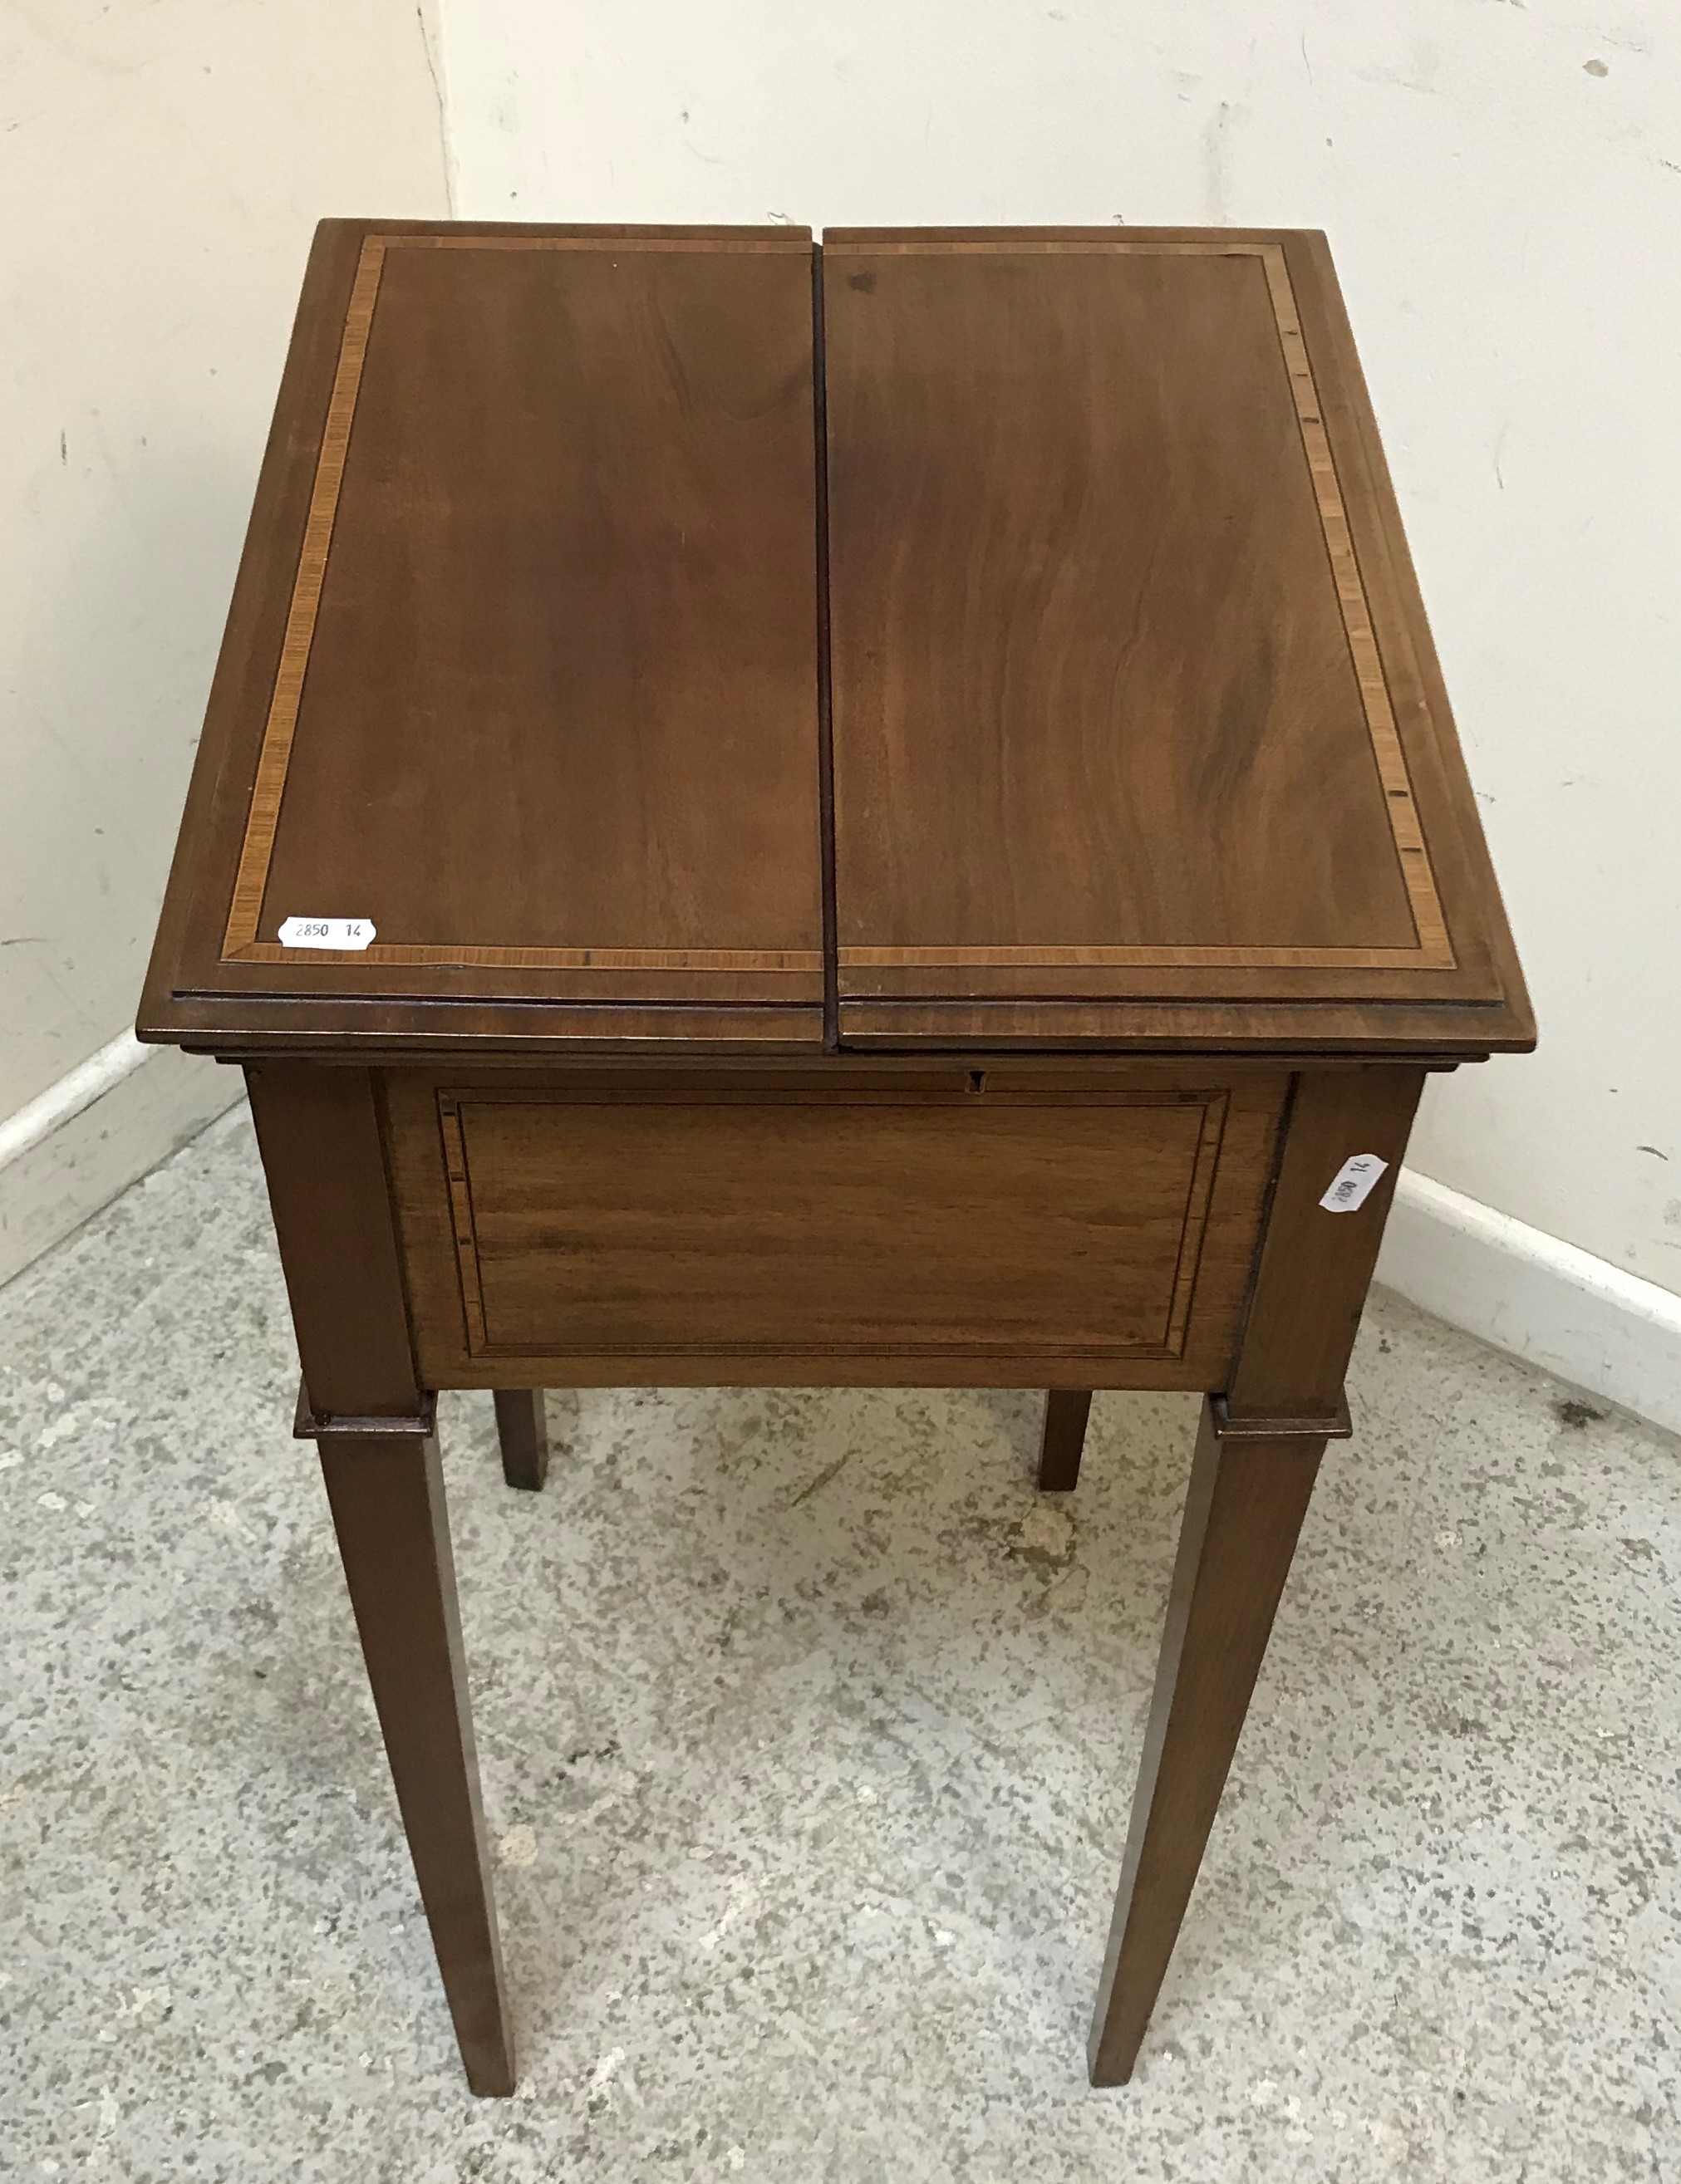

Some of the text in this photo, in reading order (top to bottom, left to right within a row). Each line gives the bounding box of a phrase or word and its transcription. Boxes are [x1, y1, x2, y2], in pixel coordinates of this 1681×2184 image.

[295, 923, 361, 937] 2850 14
[1349, 1162, 1370, 1172] 14
